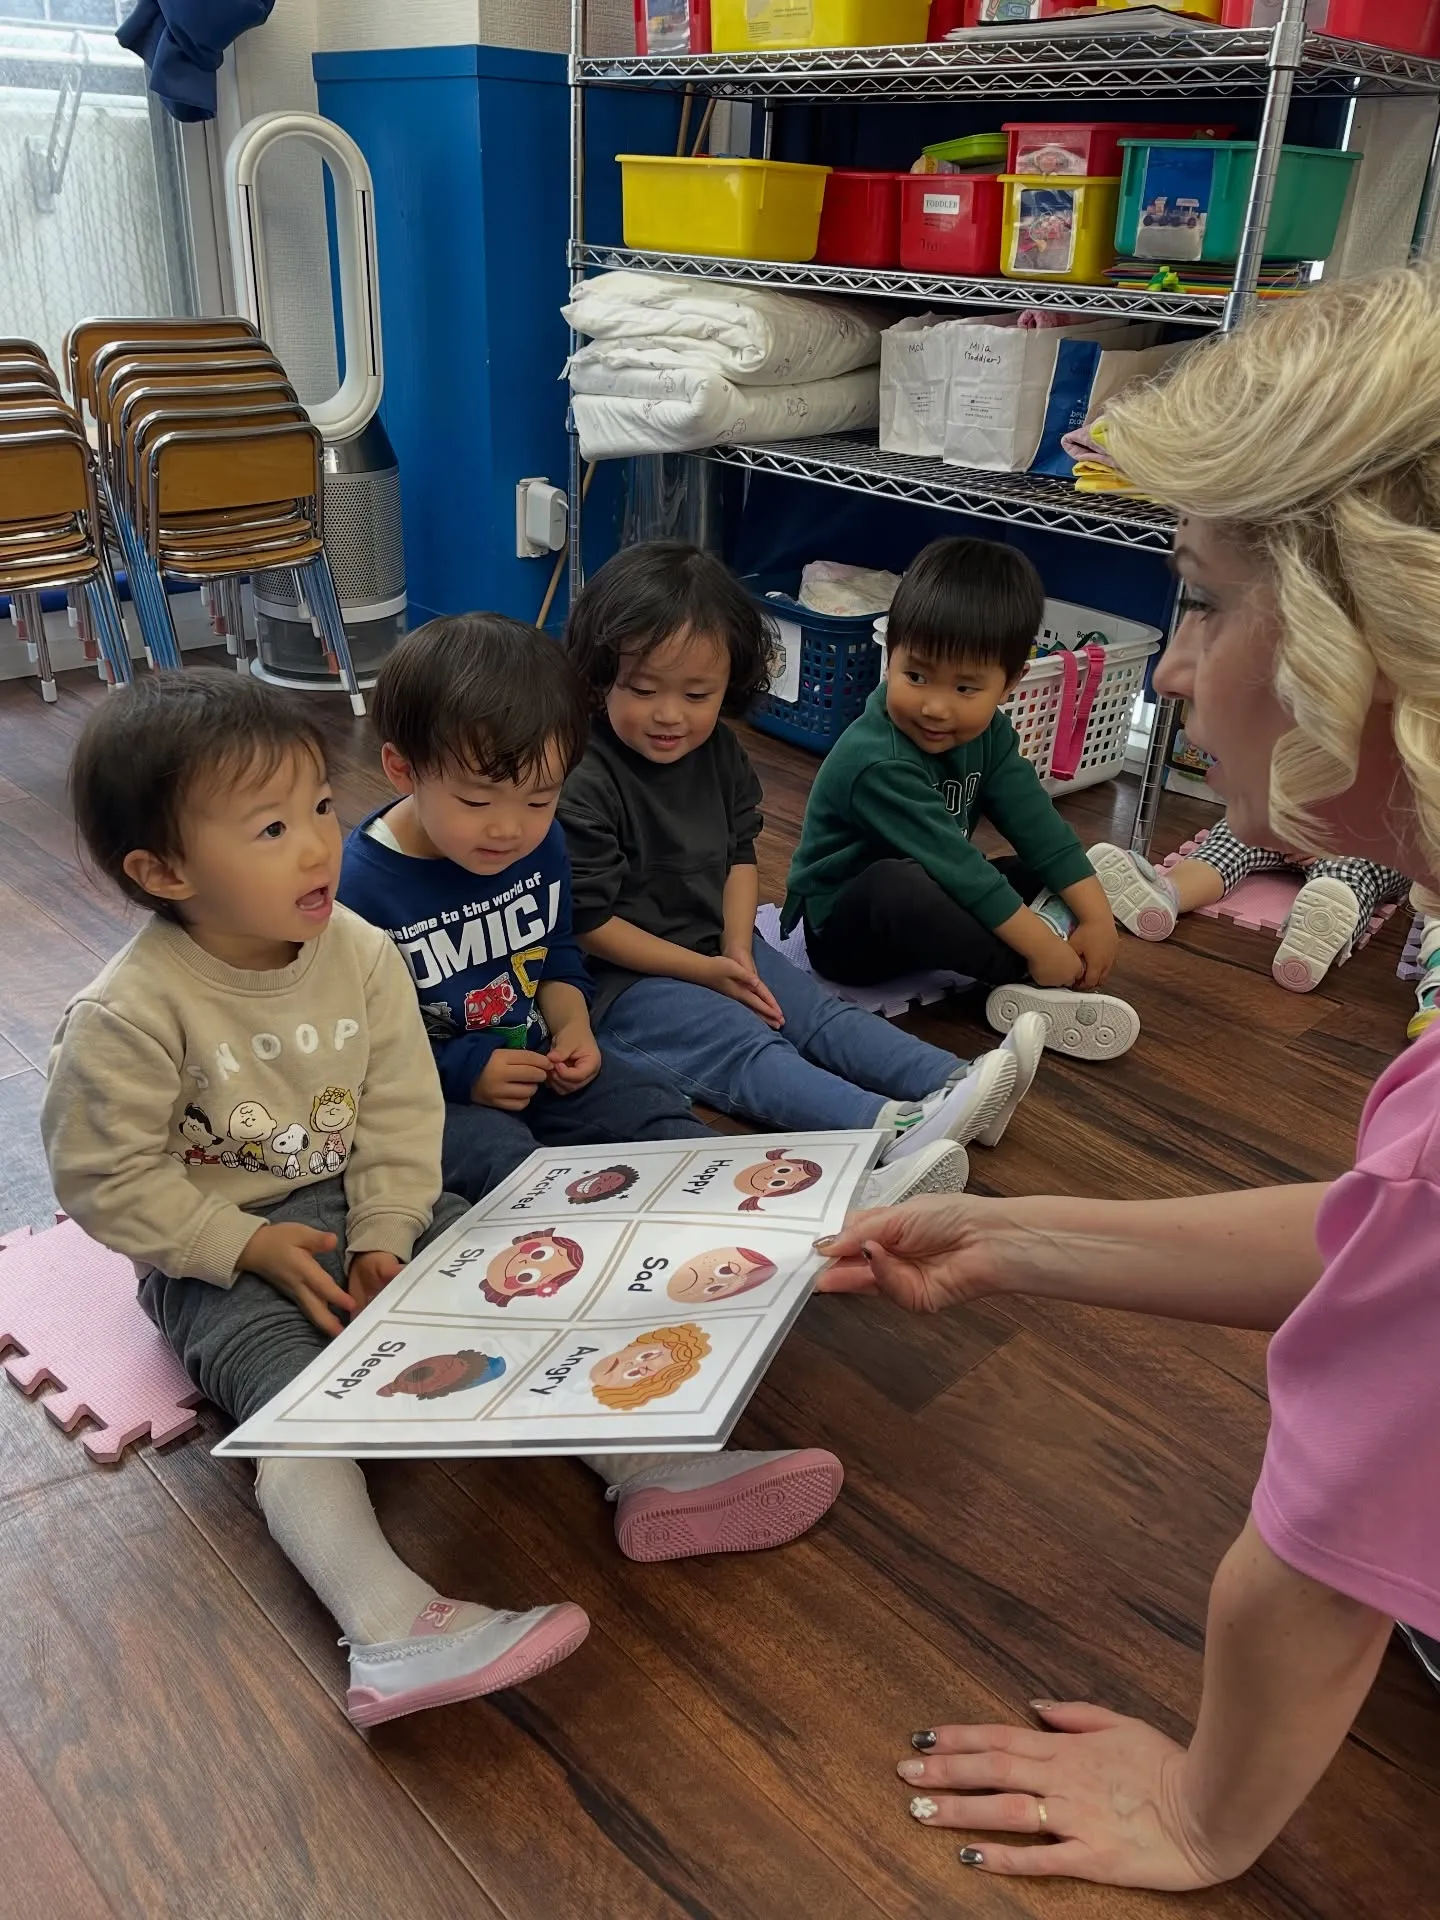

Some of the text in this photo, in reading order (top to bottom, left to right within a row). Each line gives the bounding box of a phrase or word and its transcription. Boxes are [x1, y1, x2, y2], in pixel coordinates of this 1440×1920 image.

[925, 200, 958, 209] TODDLER
[964, 351, 1001, 364] (Toddler)
[441, 911, 460, 925] to
[462, 901, 490, 918] the
[492, 882, 523, 907] world
[525, 872, 542, 889] of
[511, 1167, 572, 1209] Excited
[682, 1159, 734, 1195] Happy
[438, 1247, 485, 1278] Shy
[627, 1256, 669, 1293] Sad
[324, 1340, 407, 1400] Sleepy
[529, 1346, 599, 1396] Angry
